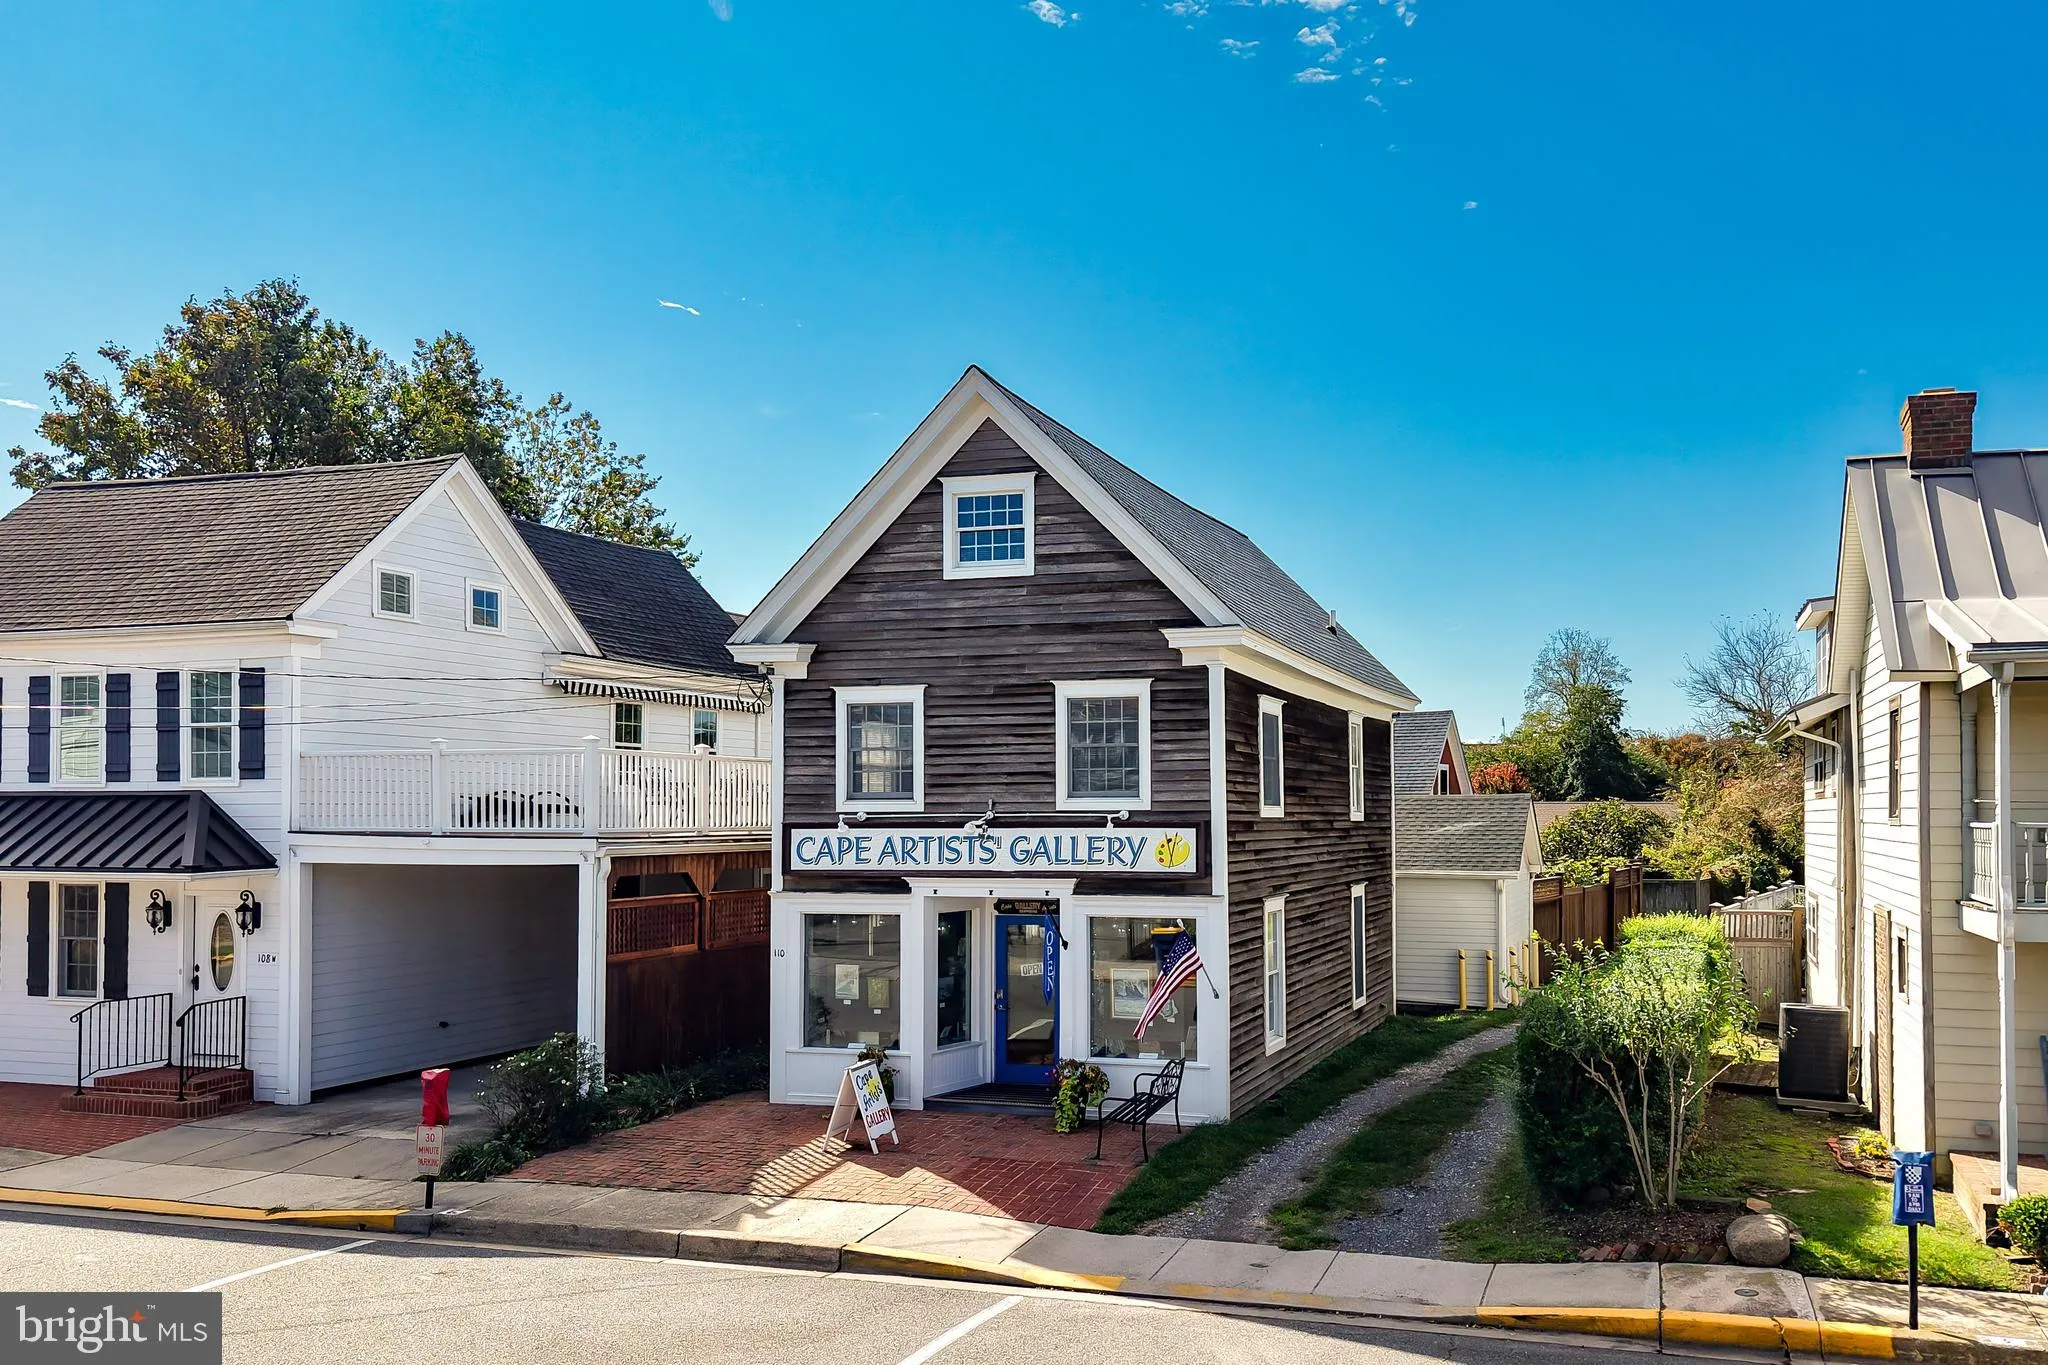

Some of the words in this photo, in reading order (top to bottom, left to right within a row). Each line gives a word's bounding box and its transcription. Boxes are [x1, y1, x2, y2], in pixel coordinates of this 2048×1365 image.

[796, 836, 872, 866] CAPE
[877, 835, 1001, 866] ARTISTS'
[1009, 835, 1148, 869] GALLERY
[774, 949, 785, 958] 110
[1046, 931, 1056, 992] OPEN
[856, 1070, 874, 1090] Cape
[865, 1106, 891, 1128] GALLERY
[425, 1133, 436, 1143] 30
[418, 1146, 440, 1155] MINUTE
[417, 1157, 440, 1167] PARKING
